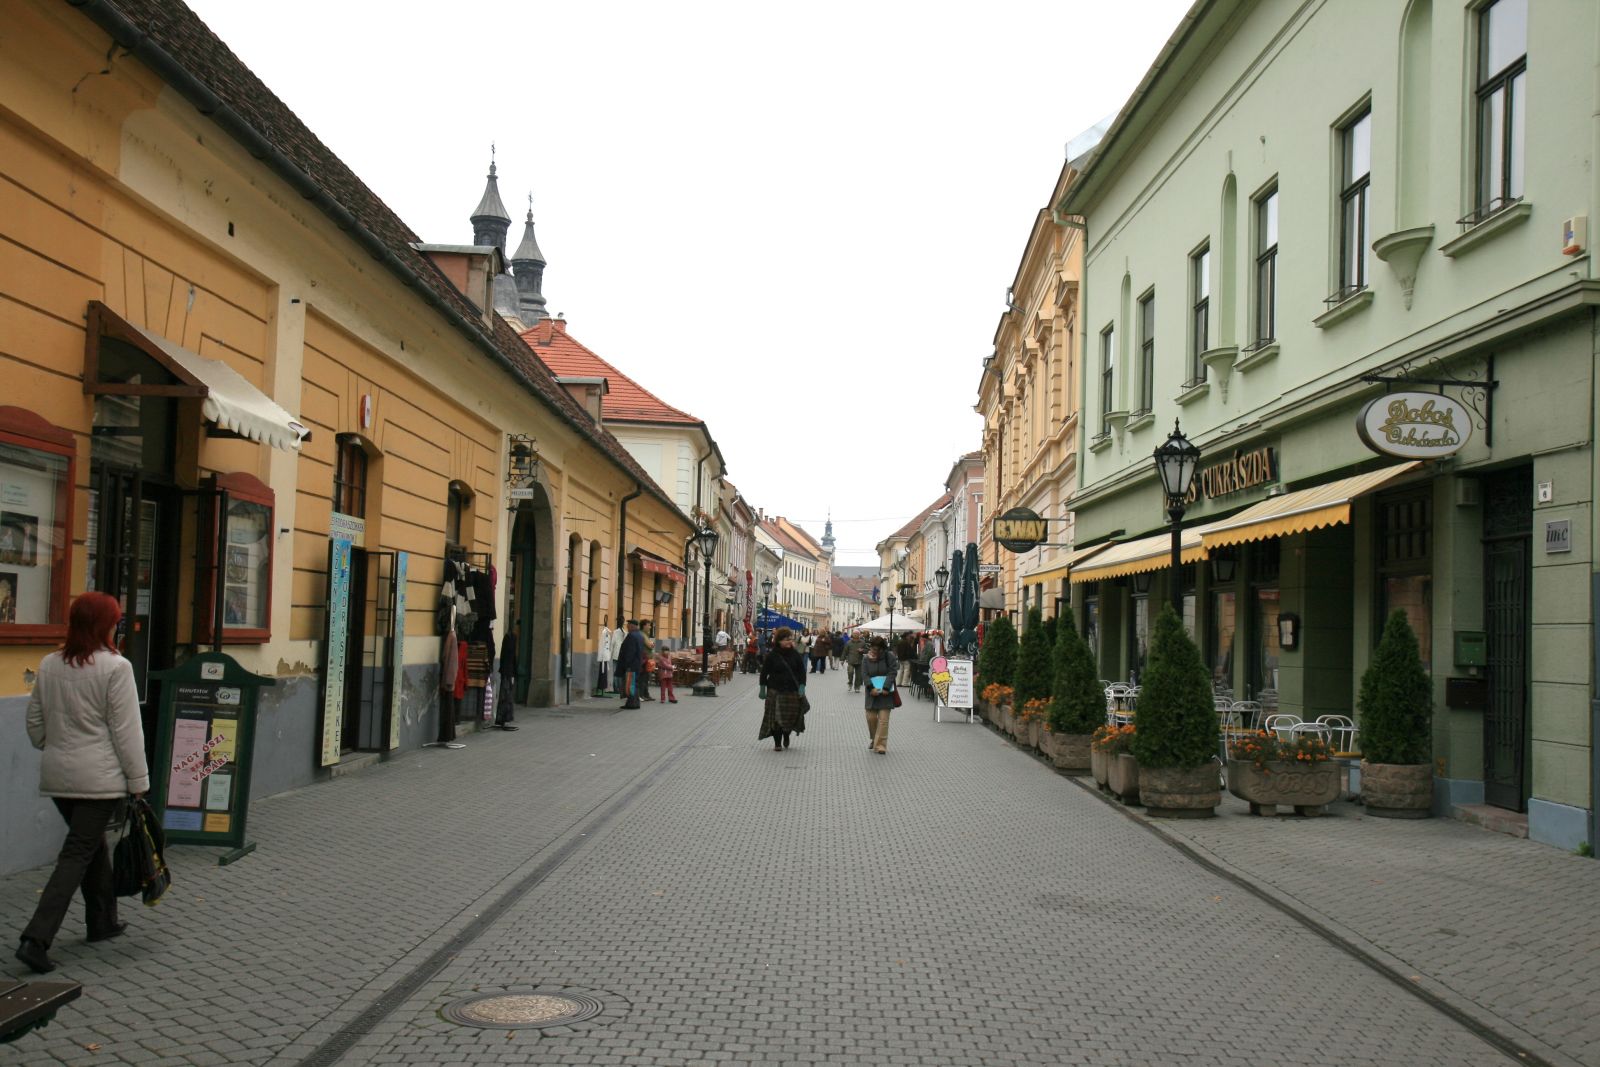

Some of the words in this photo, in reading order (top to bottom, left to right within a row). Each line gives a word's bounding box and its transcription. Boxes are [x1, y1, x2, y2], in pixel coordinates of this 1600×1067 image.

[1384, 398, 1454, 426] Dobos
[1386, 424, 1458, 448] Cukrászda
[1201, 447, 1273, 500] CUKRÁSZDA
[173, 750, 200, 773] NAGY
